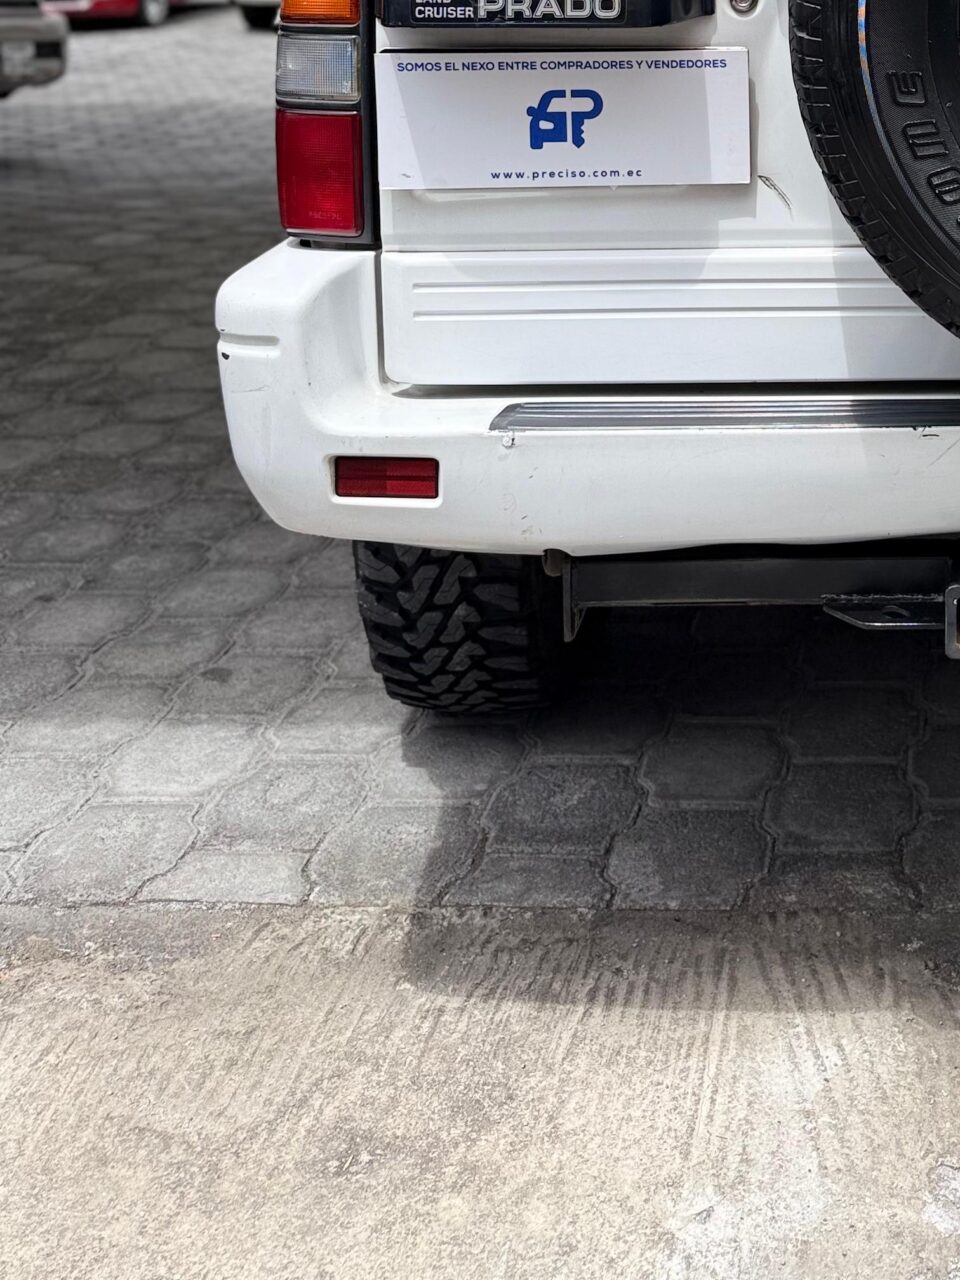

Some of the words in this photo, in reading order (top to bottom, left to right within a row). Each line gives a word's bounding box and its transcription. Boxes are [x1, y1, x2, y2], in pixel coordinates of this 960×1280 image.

[415, 6, 474, 19] CRUISER
[397, 61, 442, 72] SOMOS
[444, 61, 460, 72] EL
[461, 61, 495, 71] NEXO
[498, 60, 537, 71] ENTRE
[540, 59, 634, 71] COMPRADORES
[635, 59, 645, 70] Y
[645, 58, 728, 70] VENDEDORES
[490, 168, 643, 180] www.preciso.com.ec
